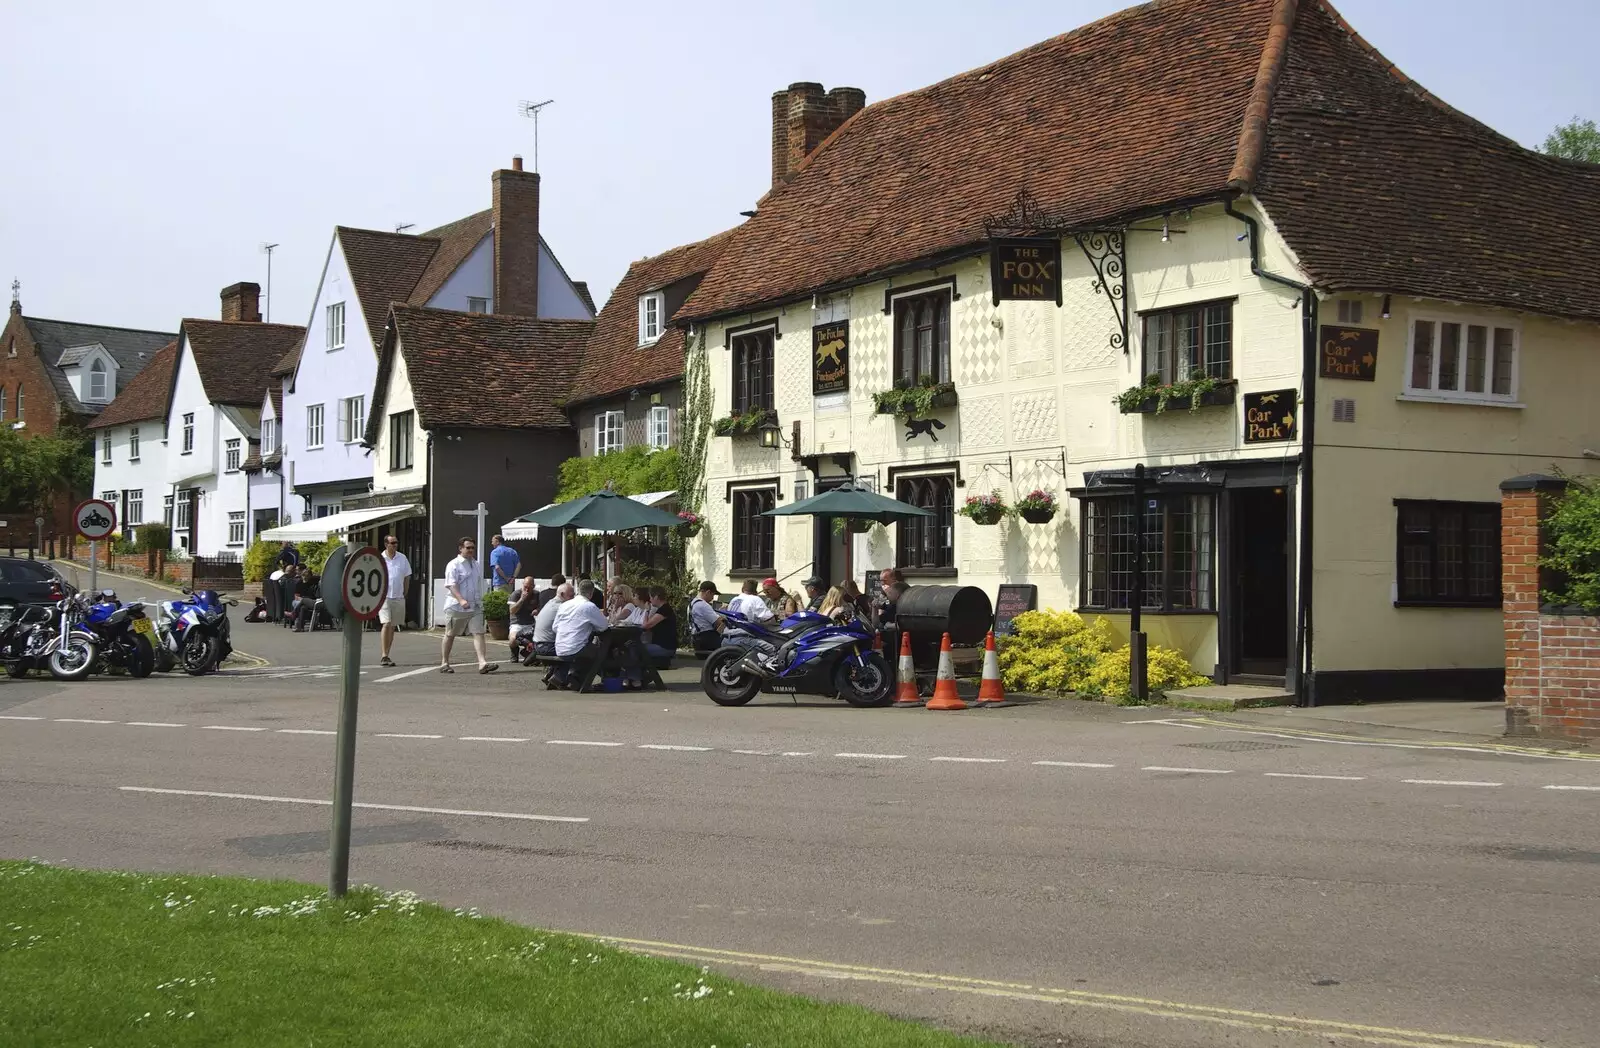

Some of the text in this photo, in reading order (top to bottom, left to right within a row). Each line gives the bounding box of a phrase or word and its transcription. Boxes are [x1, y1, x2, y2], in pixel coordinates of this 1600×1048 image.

[1014, 248, 1040, 258] THE
[1003, 261, 1056, 280] FOX
[1012, 284, 1045, 297] INN
[816, 326, 846, 342] The Fox Inn
[1325, 340, 1352, 357] Car
[1326, 356, 1361, 376] Park
[1248, 407, 1272, 422] Car
[1248, 423, 1282, 440] Park
[351, 568, 382, 598] 30
[771, 685, 797, 693] YAMAHA
